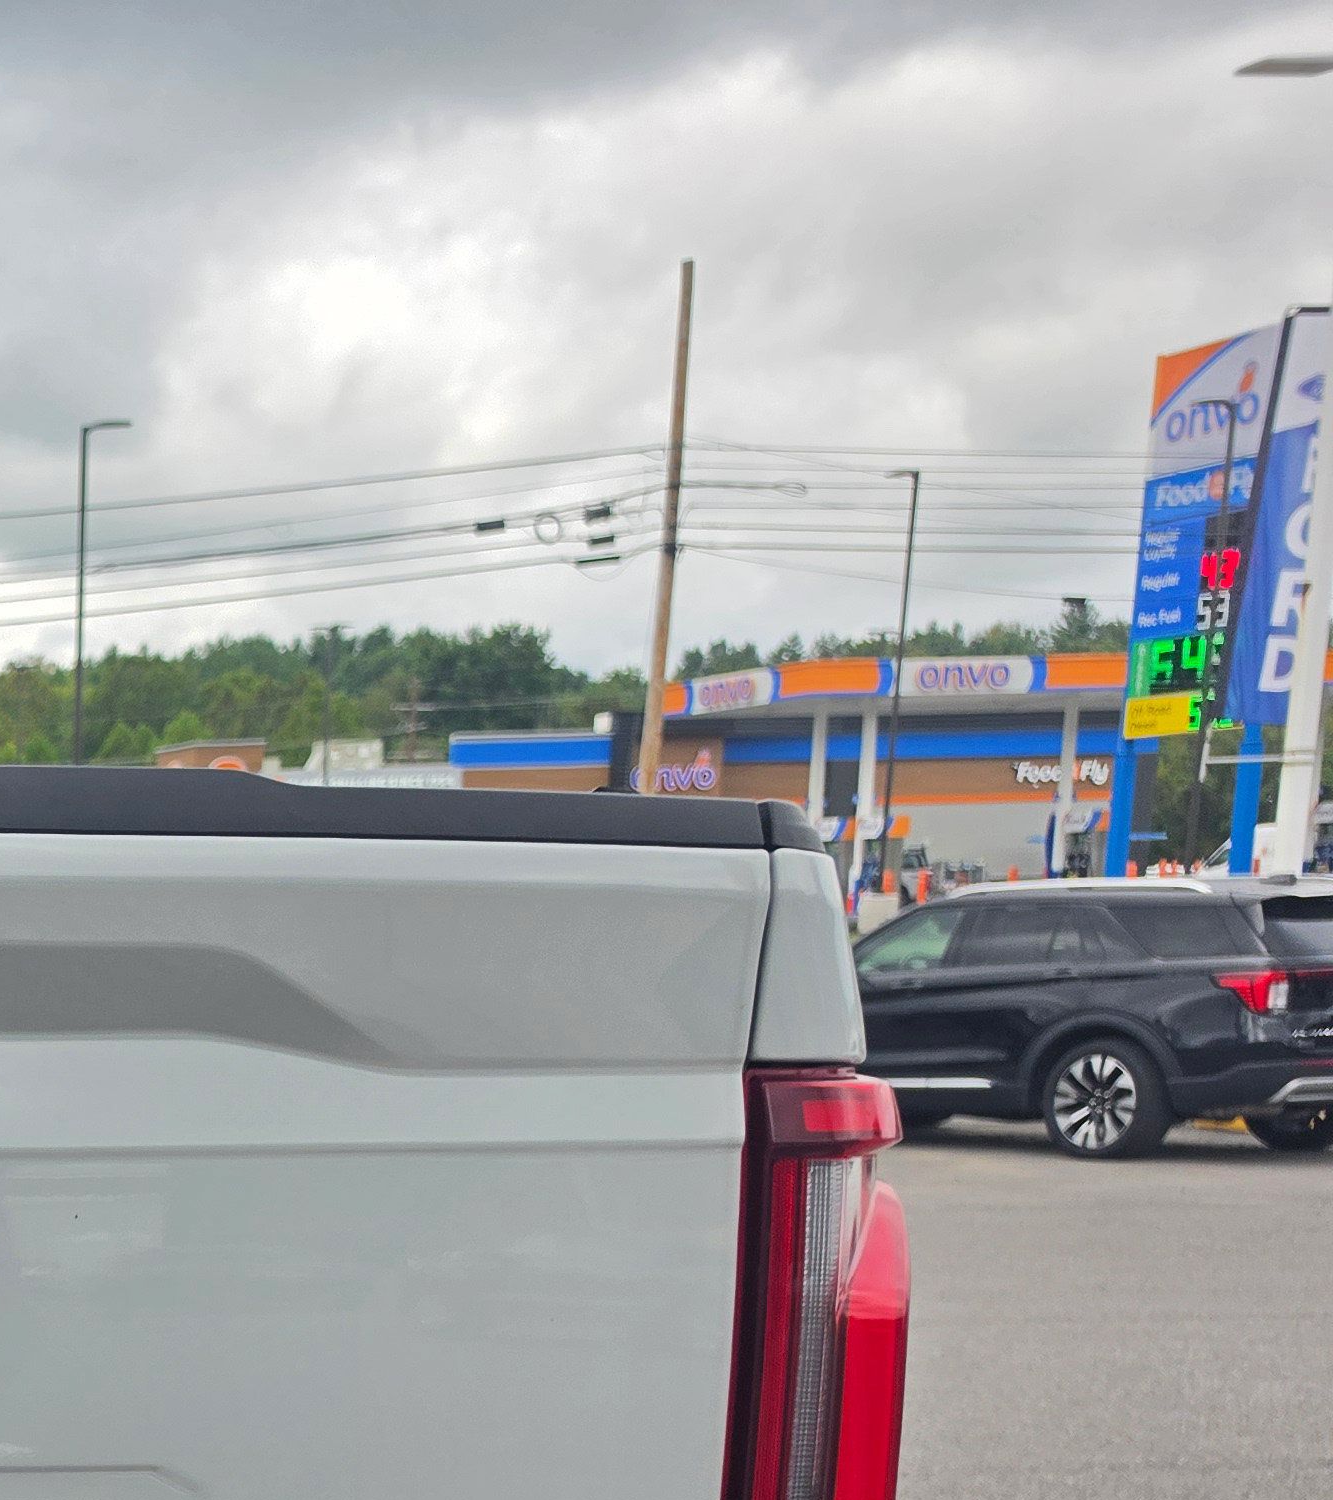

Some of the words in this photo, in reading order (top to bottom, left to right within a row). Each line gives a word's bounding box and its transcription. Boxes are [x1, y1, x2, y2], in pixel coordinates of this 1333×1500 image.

[1166, 392, 1259, 442] onvo
[917, 661, 1011, 691] onvo
[1079, 758, 1110, 786] Fly
